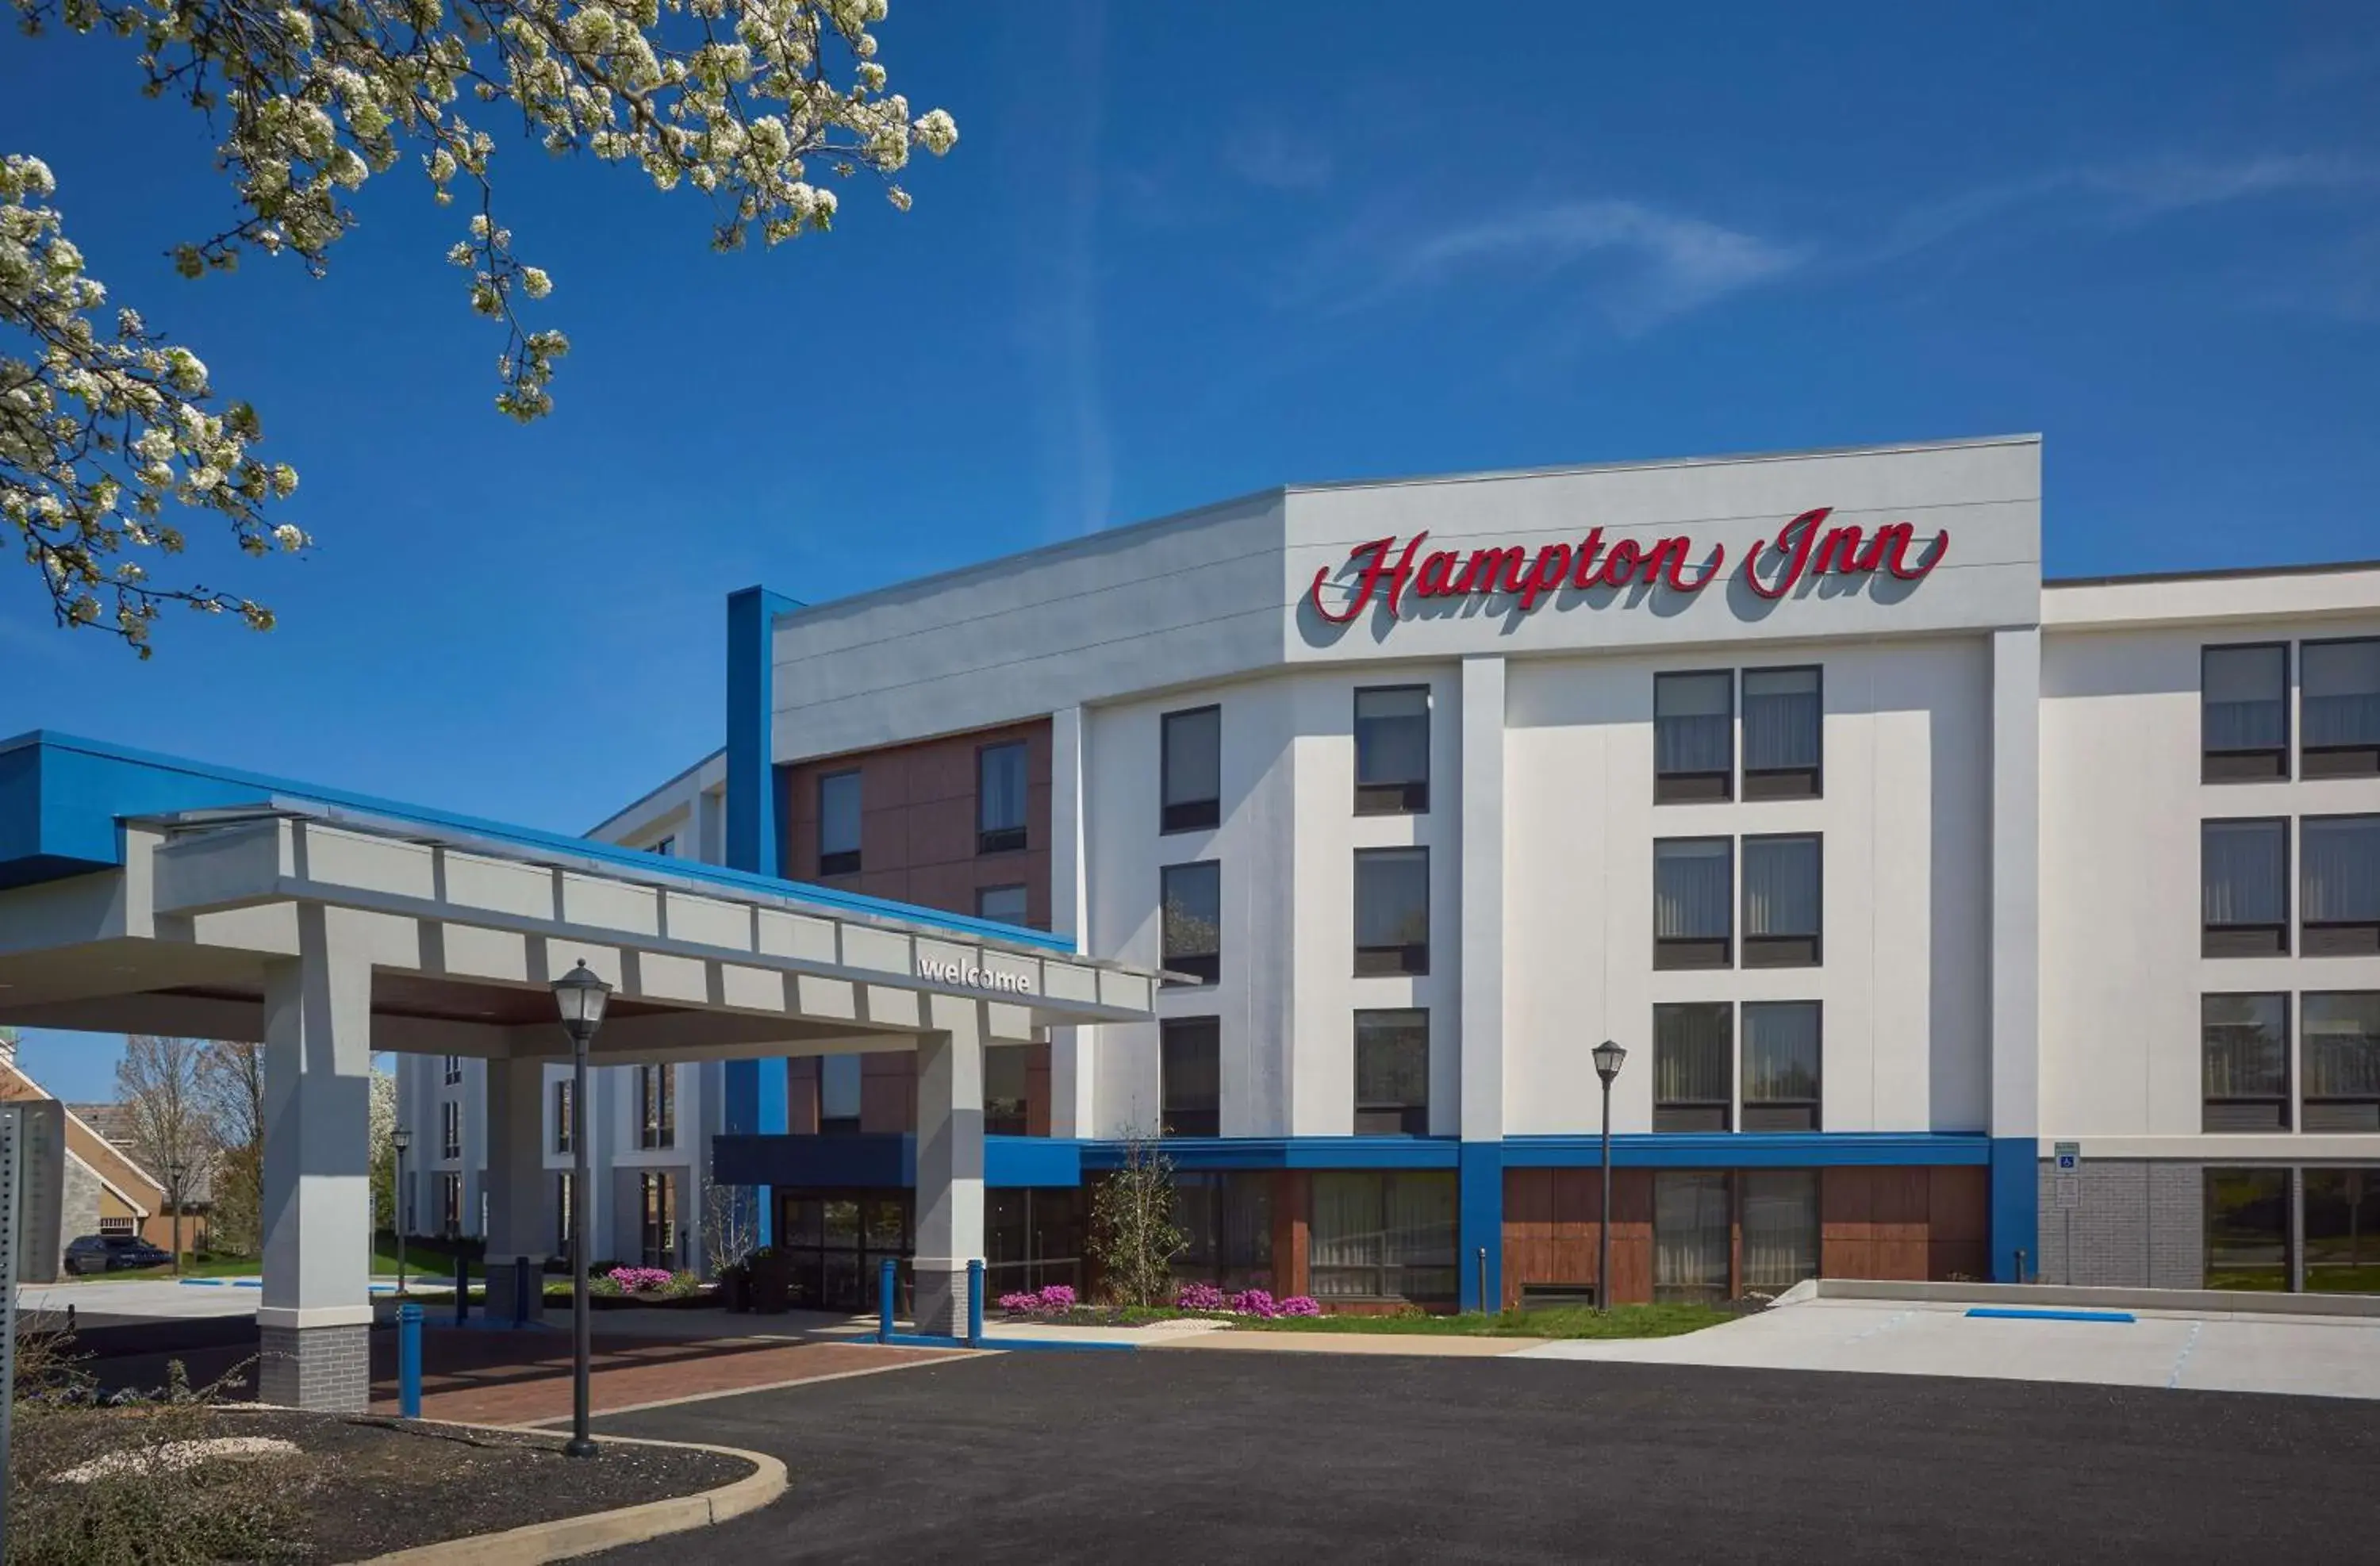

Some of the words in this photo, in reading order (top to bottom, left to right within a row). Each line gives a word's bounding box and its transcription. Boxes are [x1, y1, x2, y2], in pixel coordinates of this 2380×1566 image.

[1312, 527, 1725, 623] Hampton
[1745, 508, 1949, 599] Inn
[917, 958, 1030, 993] welcome
